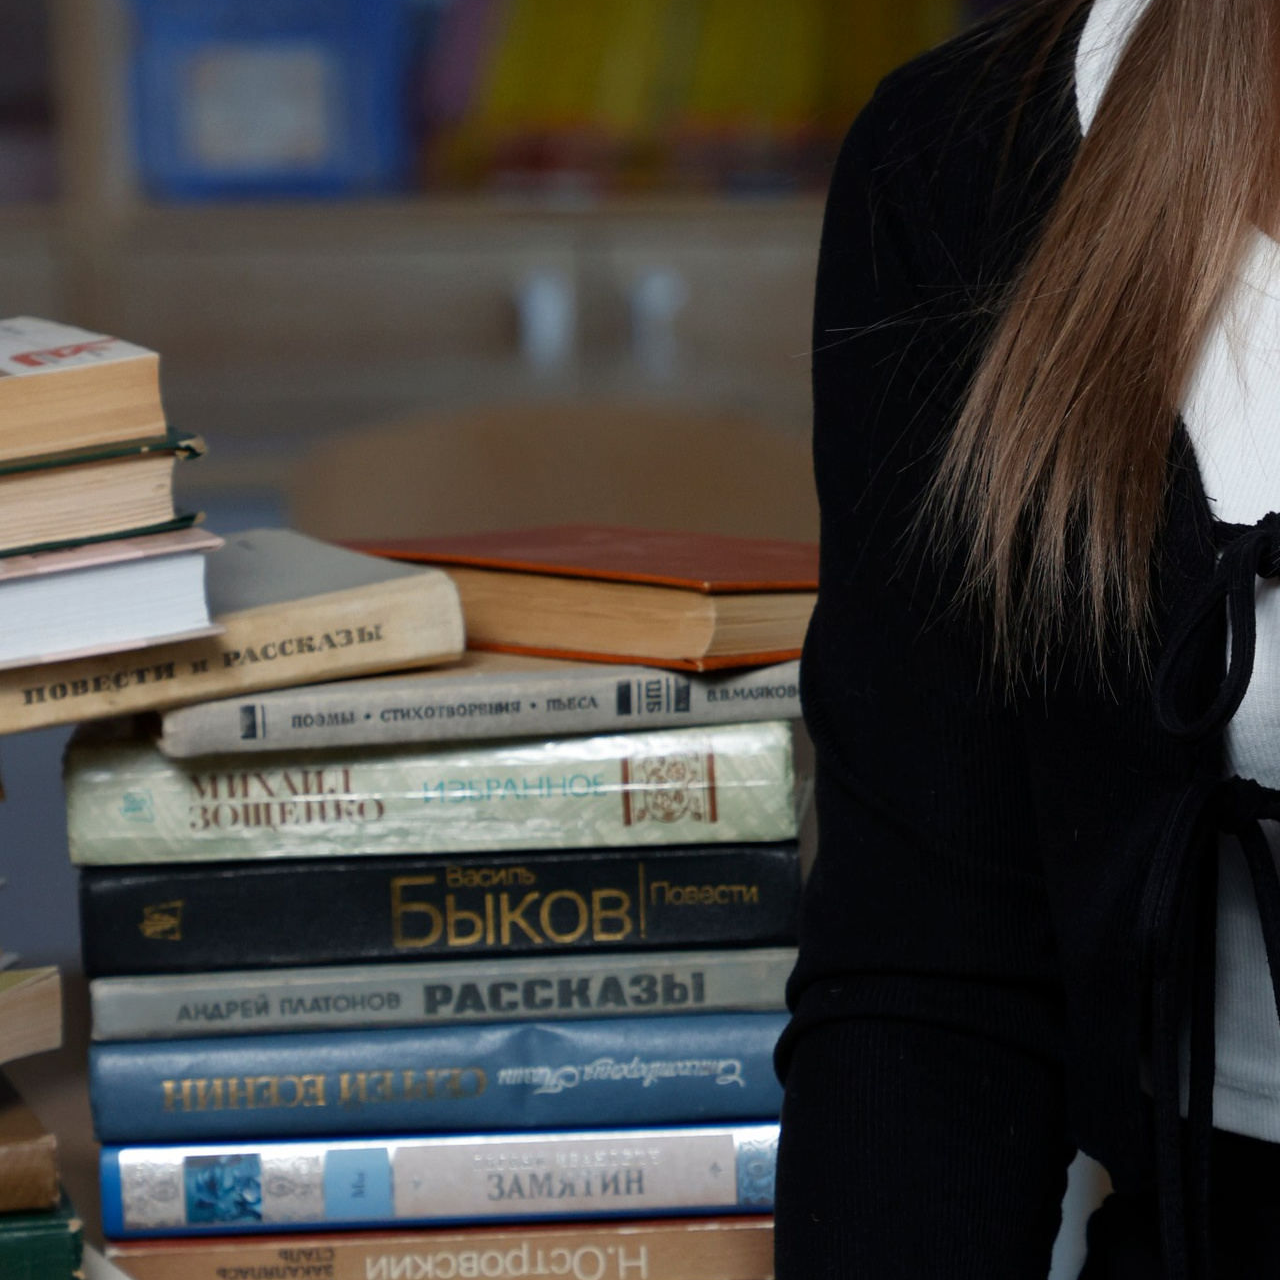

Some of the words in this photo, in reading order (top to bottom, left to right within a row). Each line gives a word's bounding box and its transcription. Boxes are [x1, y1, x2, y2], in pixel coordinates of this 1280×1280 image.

[22, 661, 175, 706] ПОВЕСТИ
[222, 624, 384, 669] РАССКАЗЫ
[707, 684, 799, 703] В.В.МАЯКОВ
[291, 711, 356, 729] ПОЭМЫ
[380, 699, 522, 723] СТИХОТВОРЕНИЯ
[190, 767, 353, 801] МИХАИЛ
[422, 773, 608, 804] ИЗБРАННОЕ
[188, 797, 386, 832] ЗОЩЕНКО
[446, 864, 536, 888] Василь
[650, 881, 760, 906] Повести
[176, 993, 270, 1022] АНДРЕЙ
[279, 992, 400, 1015] ПЛАТОНОВ
[424, 973, 706, 1015] РАССКАЗЫ
[162, 1074, 328, 1113] ЕСЕНИН
[339, 1066, 488, 1109] СЕРГЕЙ
[487, 1168, 645, 1201] ЗАМЯТИН
